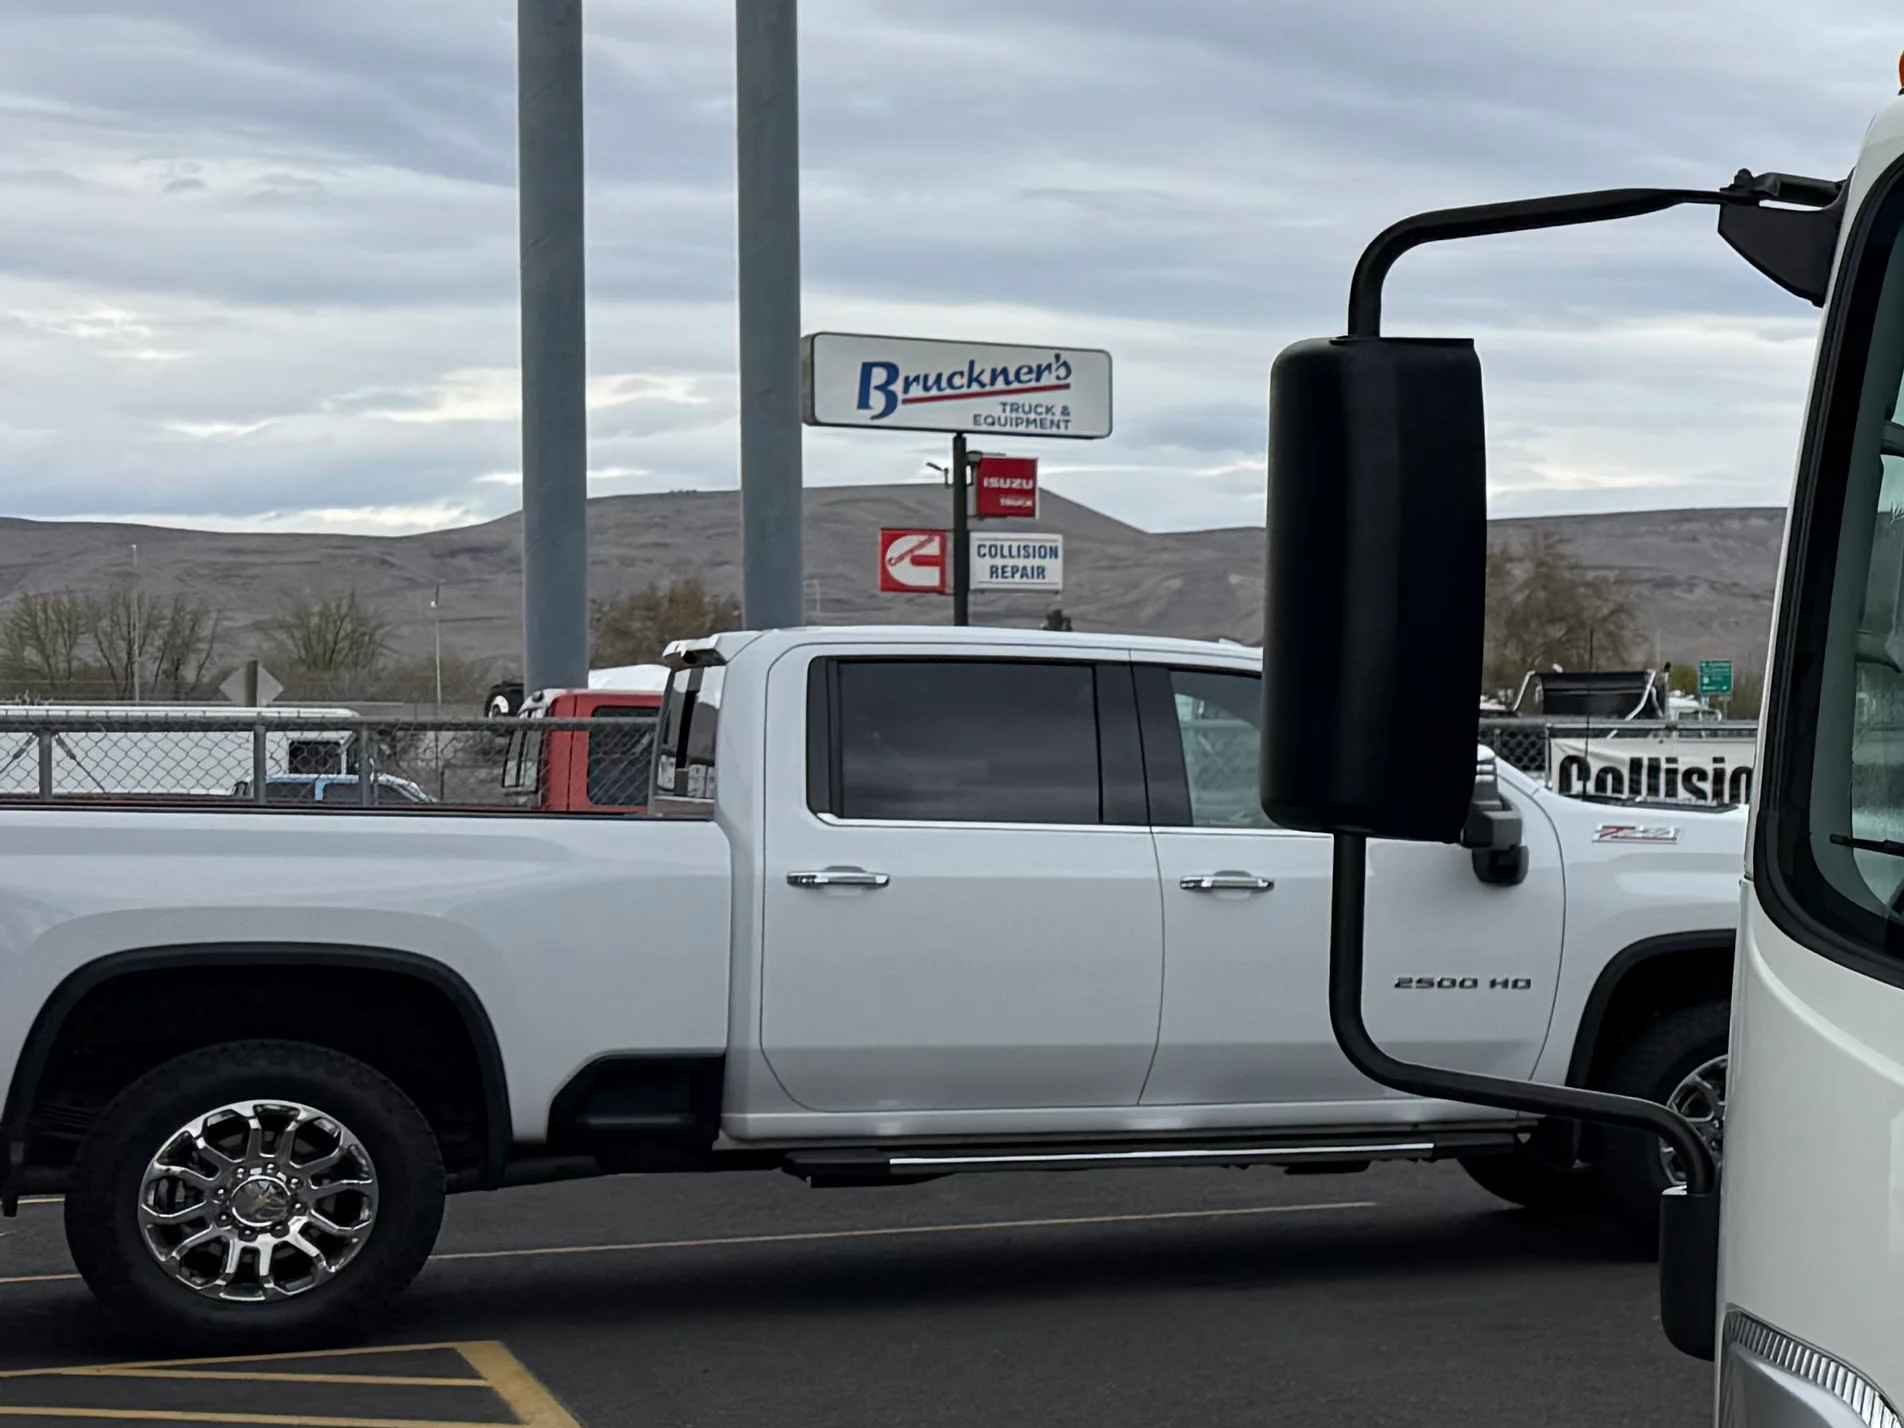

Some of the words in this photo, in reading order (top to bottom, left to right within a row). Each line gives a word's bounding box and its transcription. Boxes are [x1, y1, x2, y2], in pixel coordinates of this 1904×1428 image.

[856, 352, 1073, 421] Bruckner's
[999, 401, 1056, 417] TRUCK
[1060, 405, 1071, 417] &
[972, 413, 1072, 431] EQUIPMENT
[983, 476, 1033, 489] ISUZU
[976, 543, 1059, 560] COLLISION
[989, 564, 1046, 580] REPAIR
[1394, 976, 1479, 990] 2500
[1489, 977, 1532, 990] HD
